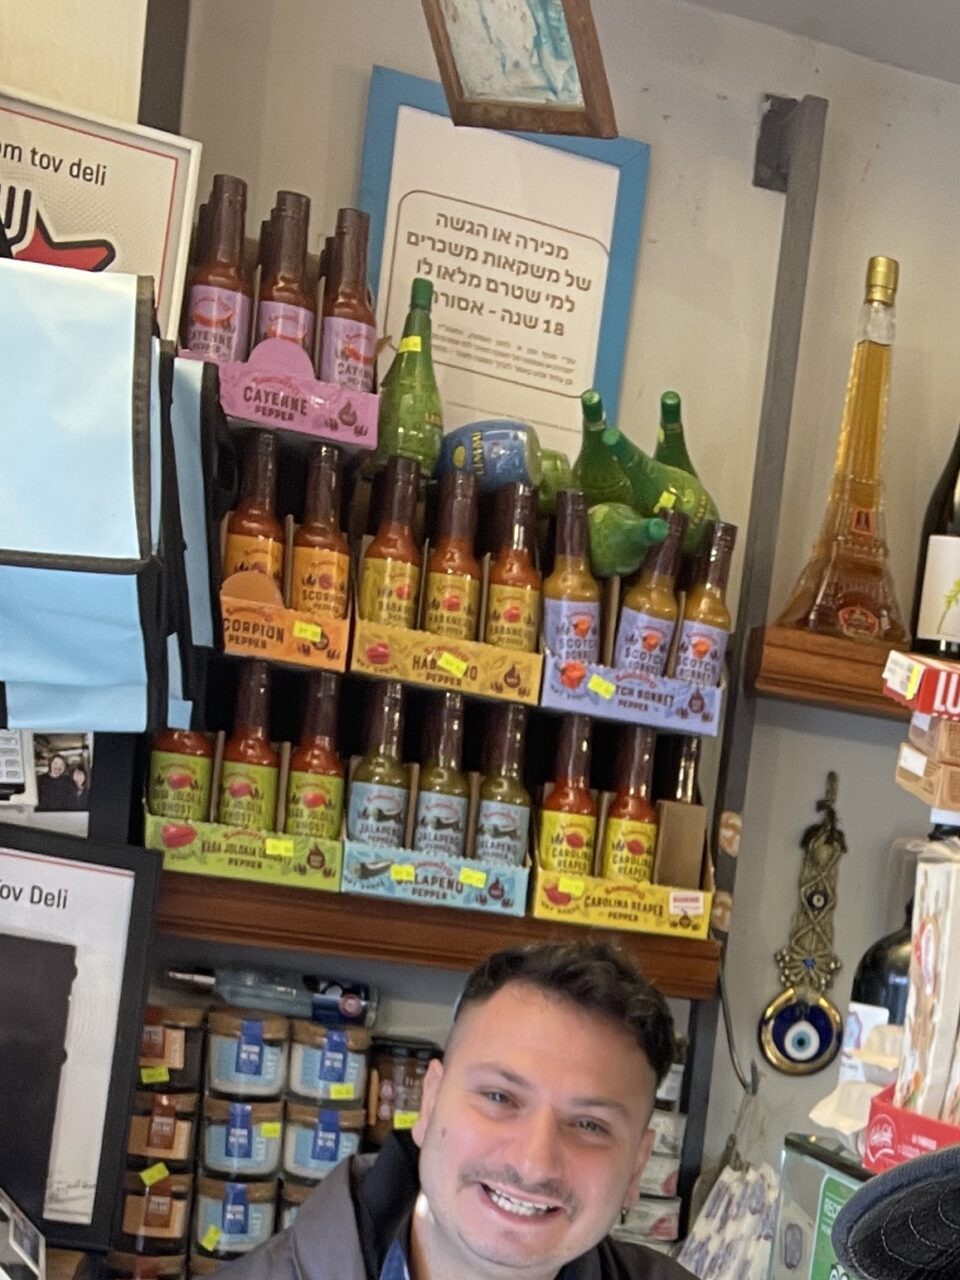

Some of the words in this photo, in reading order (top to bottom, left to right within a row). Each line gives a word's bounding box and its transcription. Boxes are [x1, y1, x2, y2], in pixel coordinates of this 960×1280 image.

[0, 142, 22, 163] m
[30, 146, 64, 173] tov
[69, 157, 108, 186] deli
[435, 212, 489, 240] הגשה
[492, 227, 512, 245] או
[406, 230, 479, 263] משכרים
[515, 233, 570, 261] מכירה
[416, 257, 433, 275] לו
[436, 263, 482, 289] מלאו
[482, 250, 561, 285] משקאות
[485, 277, 542, 305] שטרם
[565, 269, 593, 292] של
[545, 292, 576, 313] למי
[500, 308, 539, 330] שנה
[543, 319, 565, 337] 18
[243, 385, 309, 417] CAYENNE
[254, 404, 295, 422] PEPPER
[223, 617, 286, 644] CORPION
[228, 633, 268, 650] PEPPER
[425, 672, 463, 687] PEPPER
[228, 857, 263, 870] PEPPER
[0, 878, 24, 902] ov
[30, 884, 68, 910] Deli
[411, 887, 448, 900] PEPPER
[583, 895, 630, 911] CAROLINA
[631, 900, 664, 918] REAPER
[608, 911, 639, 922] PEPPER
